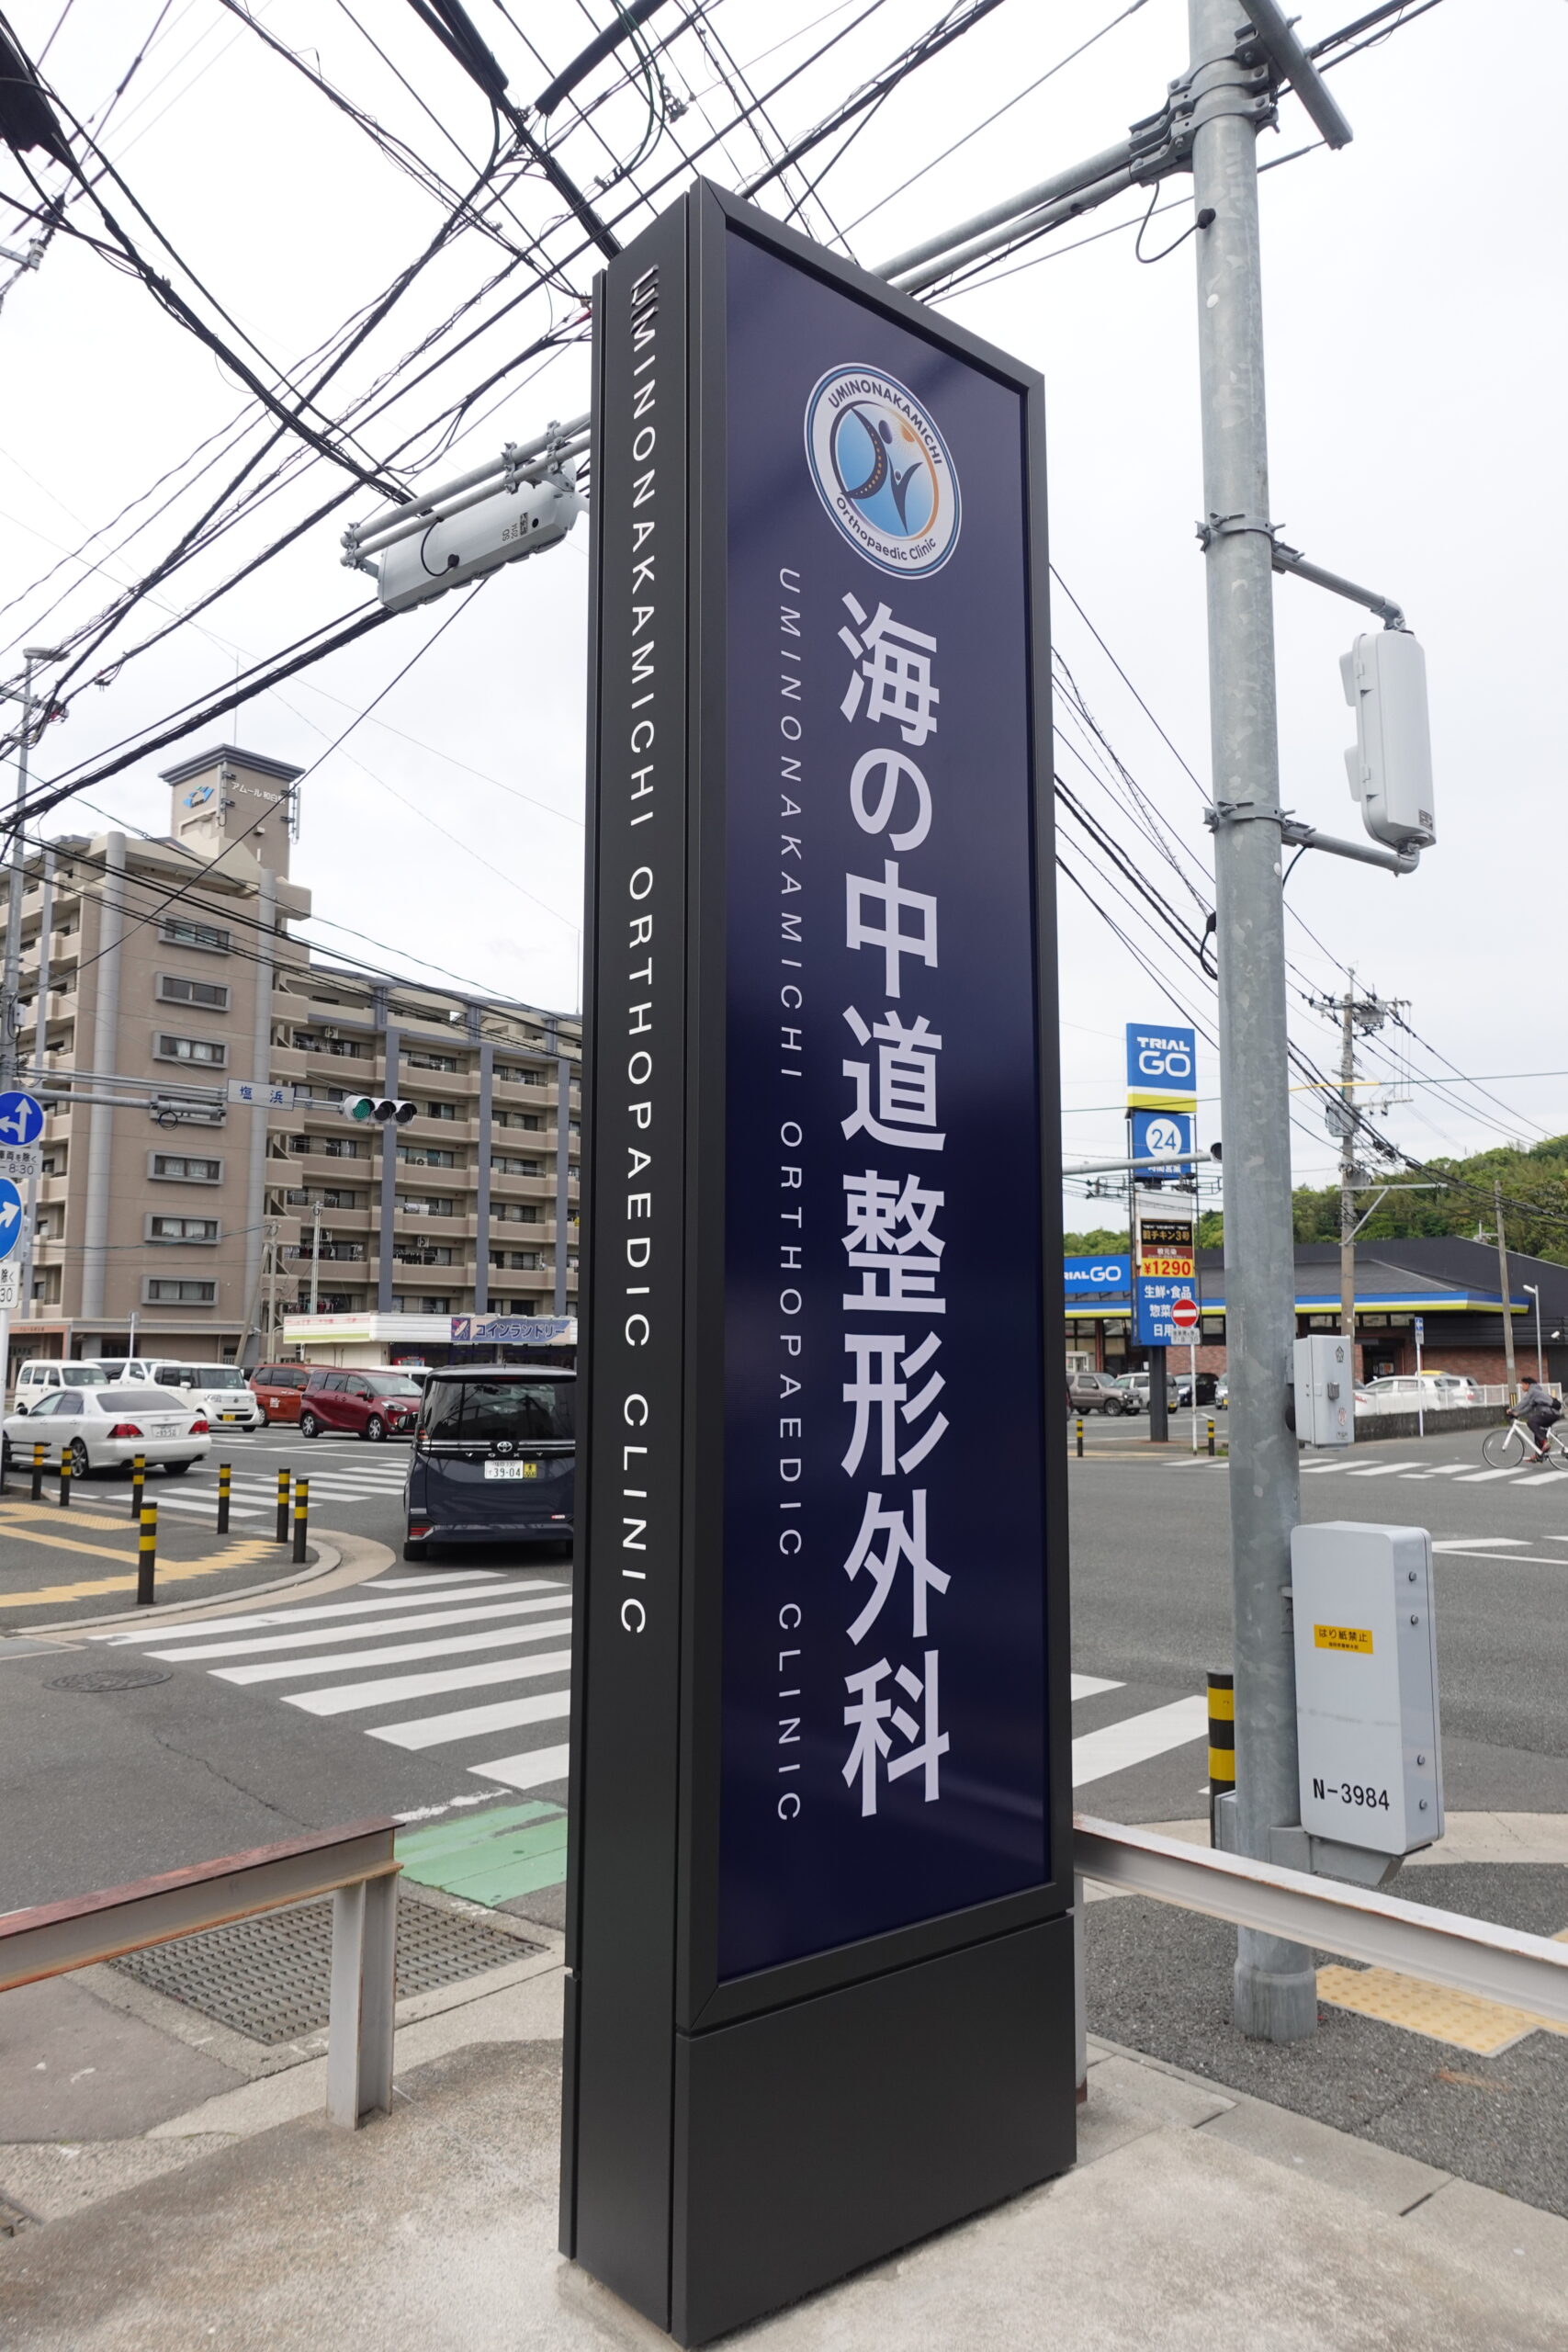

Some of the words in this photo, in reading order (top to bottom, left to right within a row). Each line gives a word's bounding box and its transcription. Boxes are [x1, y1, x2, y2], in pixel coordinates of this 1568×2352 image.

[828, 379, 942, 465] UMINONAKAMICHI
[837, 497, 908, 561] Orthopaedic
[908, 537, 937, 560] Clinic
[779, 568, 802, 1077] UMINONAKAMICHI
[1136, 1036, 1190, 1052] TRIAL
[1138, 1050, 1191, 1078] GO
[626, 865, 654, 1347] ORTHOPAEDIC
[1151, 1128, 1177, 1150] 24
[837, 592, 952, 1817] 海の中道整形外科
[1063, 1271, 1089, 1280] RIAL
[1089, 1265, 1122, 1282] GO
[1144, 1260, 1191, 1276] ¥1290
[475, 1323, 566, 1339] コインランドリー
[779, 1121, 802, 1555] ORTHOPAEDIC
[1154, 1323, 1175, 1338] 日用
[621, 1393, 649, 1634] CLINIC
[1318, 1628, 1368, 1643] はり紙禁止
[778, 1603, 802, 1820] CLINIC
[1313, 1778, 1390, 1812] N-3984
